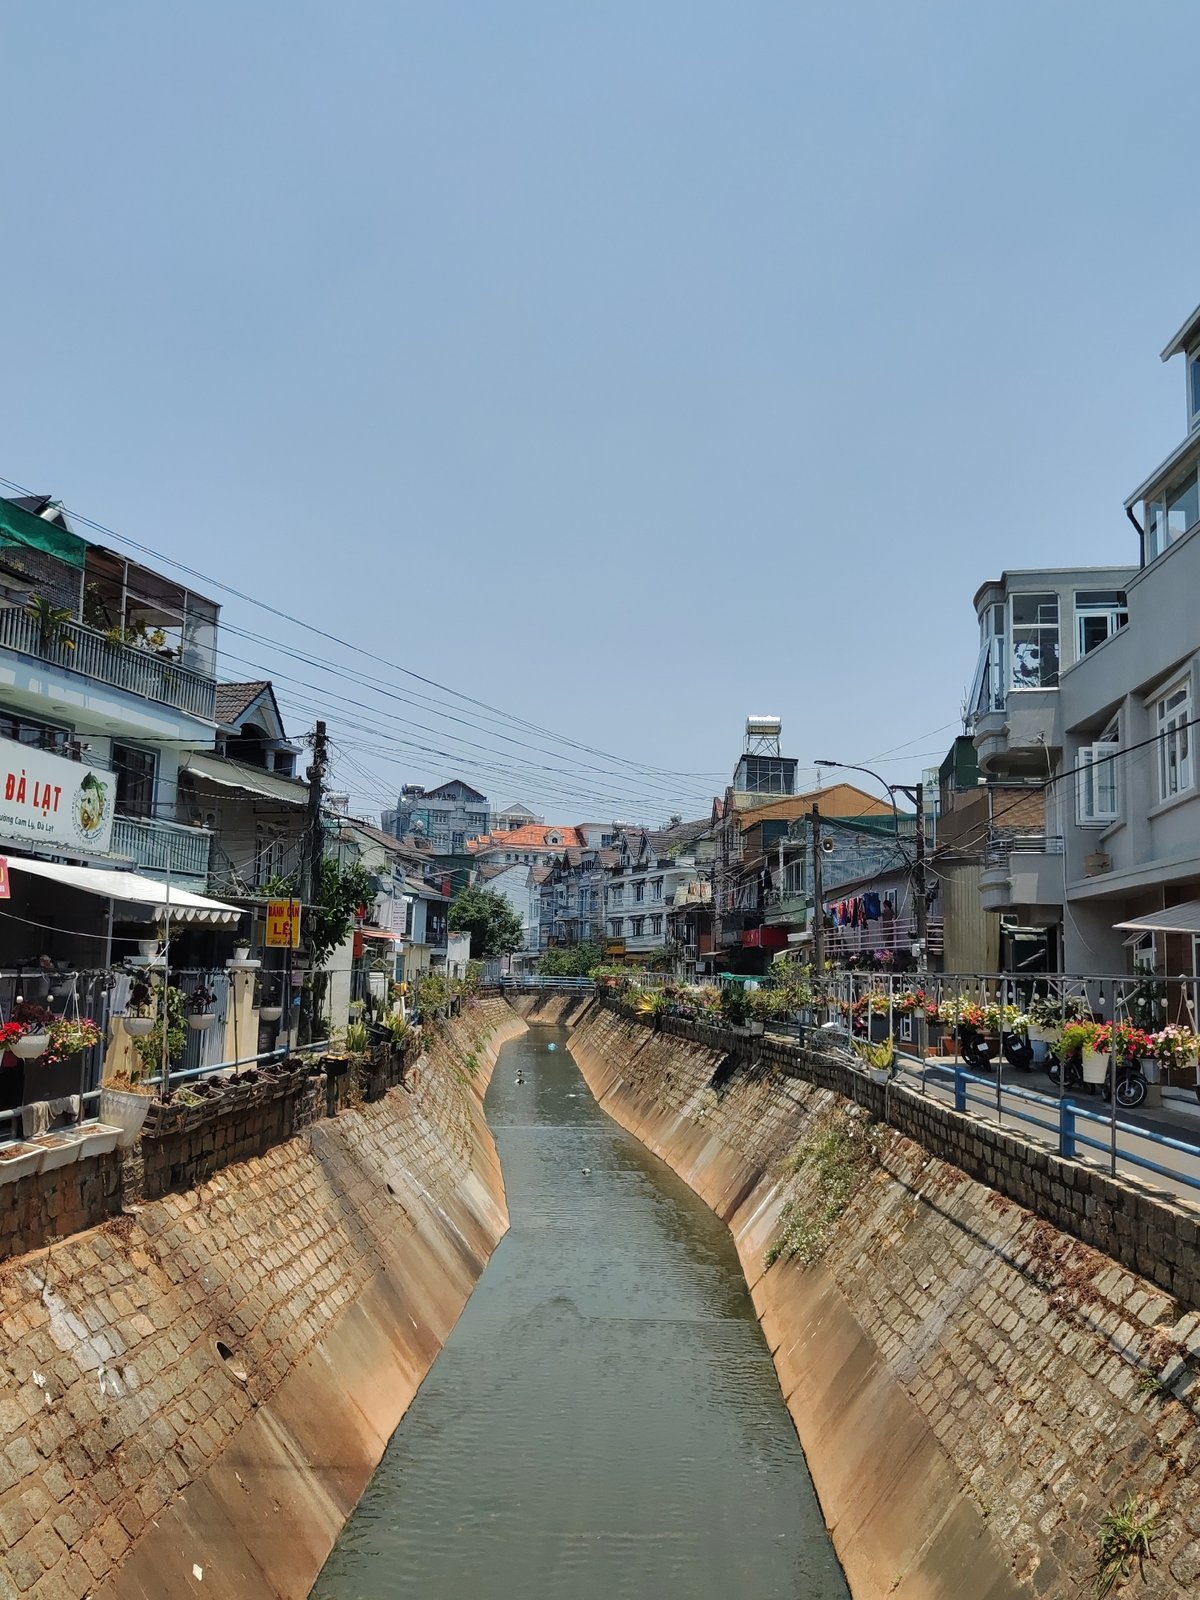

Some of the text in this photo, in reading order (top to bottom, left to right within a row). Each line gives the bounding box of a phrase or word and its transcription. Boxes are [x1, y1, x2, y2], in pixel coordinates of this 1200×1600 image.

[5, 769, 26, 804] ĐÀ
[33, 781, 62, 817] LẠT
[14, 816, 27, 827] Cam
